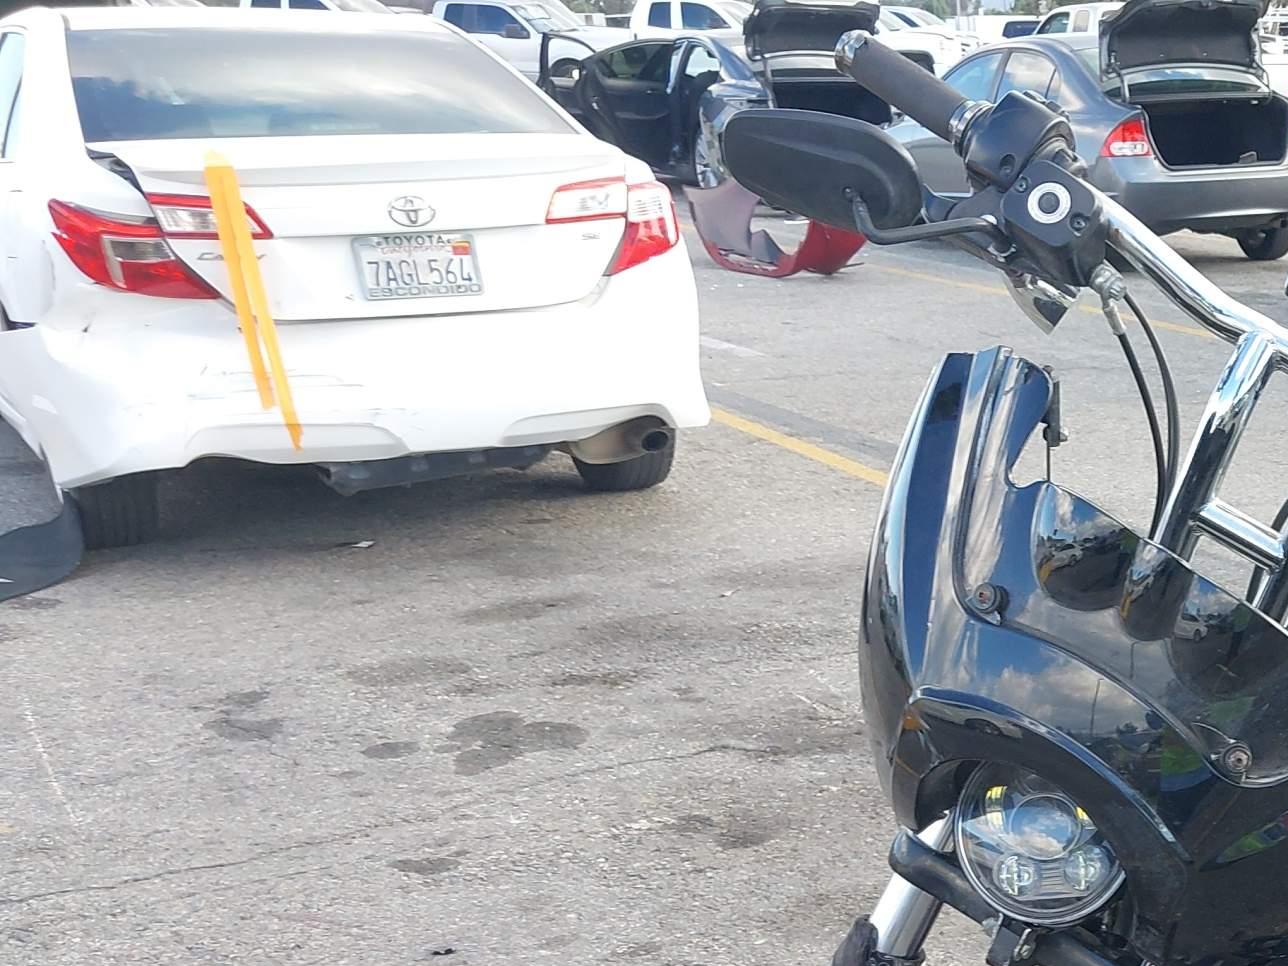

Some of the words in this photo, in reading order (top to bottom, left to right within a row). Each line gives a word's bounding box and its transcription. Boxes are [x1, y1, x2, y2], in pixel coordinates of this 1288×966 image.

[383, 234, 445, 247] TOYOTA
[366, 258, 473, 287] 7AGL564
[368, 283, 482, 298] ESCONDIDO
